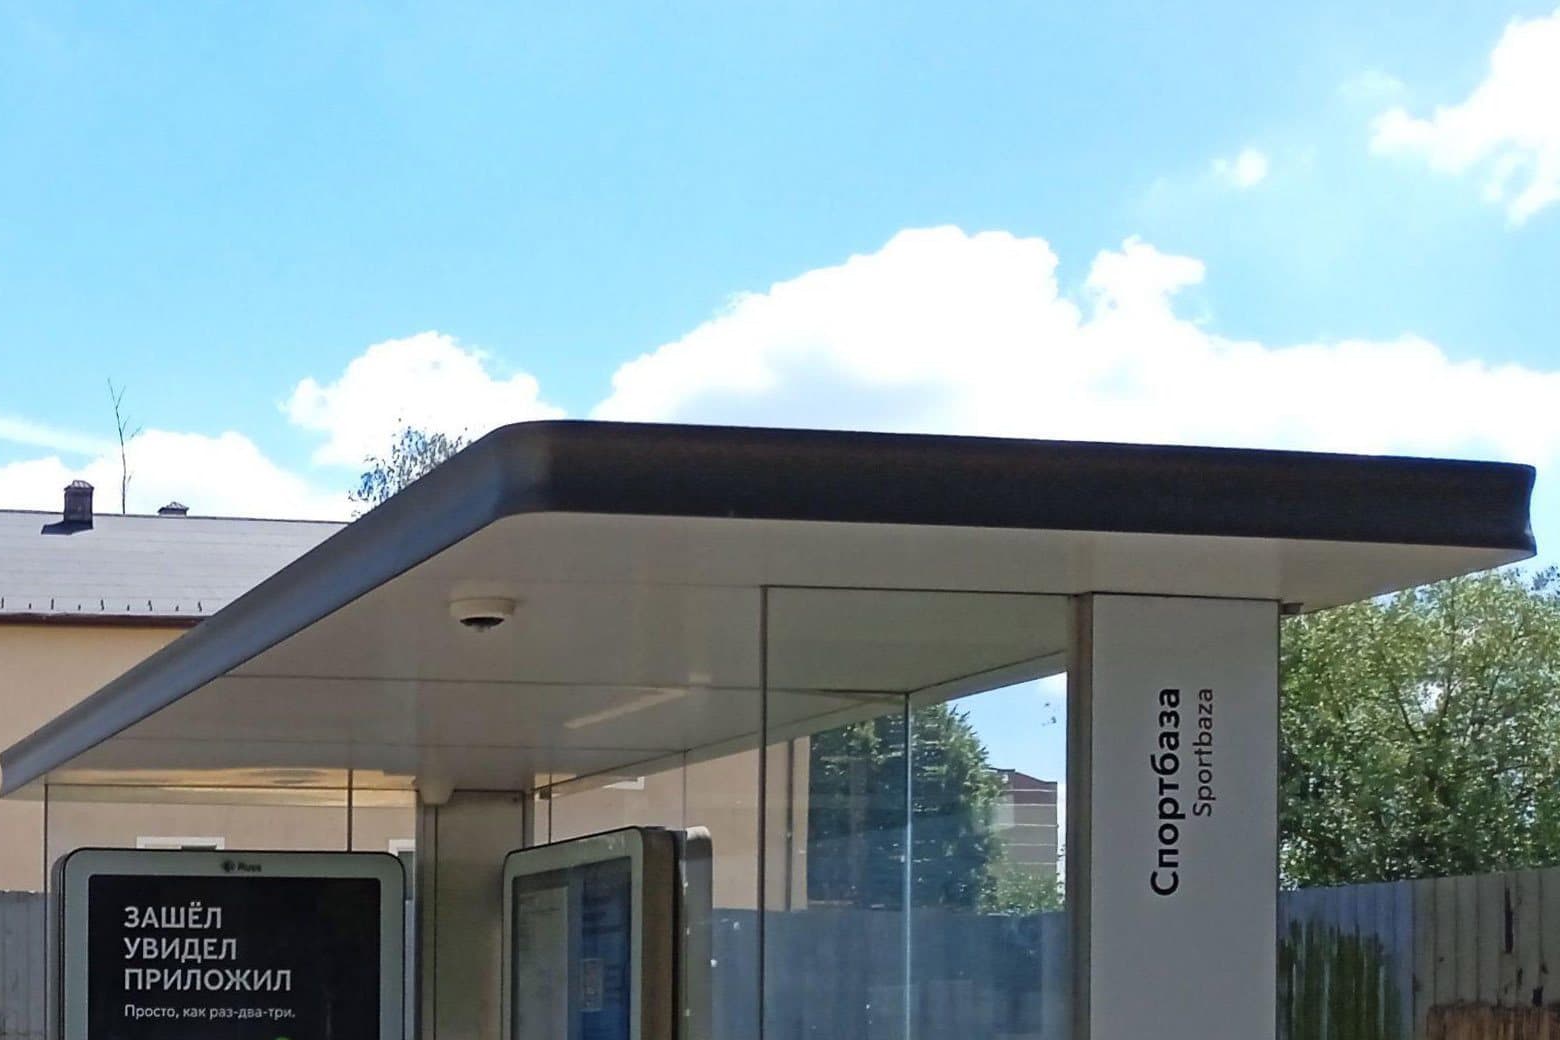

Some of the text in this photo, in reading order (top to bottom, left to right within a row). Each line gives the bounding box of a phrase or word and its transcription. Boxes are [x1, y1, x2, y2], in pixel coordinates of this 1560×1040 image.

[1192, 688, 1216, 817] Sportbaza
[1150, 688, 1186, 896] Спортбаза
[123, 901, 222, 928] ЗАШЁЛ
[123, 937, 237, 963] УВИДЕЛ
[124, 968, 291, 991] ПРИЛОЖИЛ
[124, 1004, 296, 1020] Просто, как раз-два-три.
